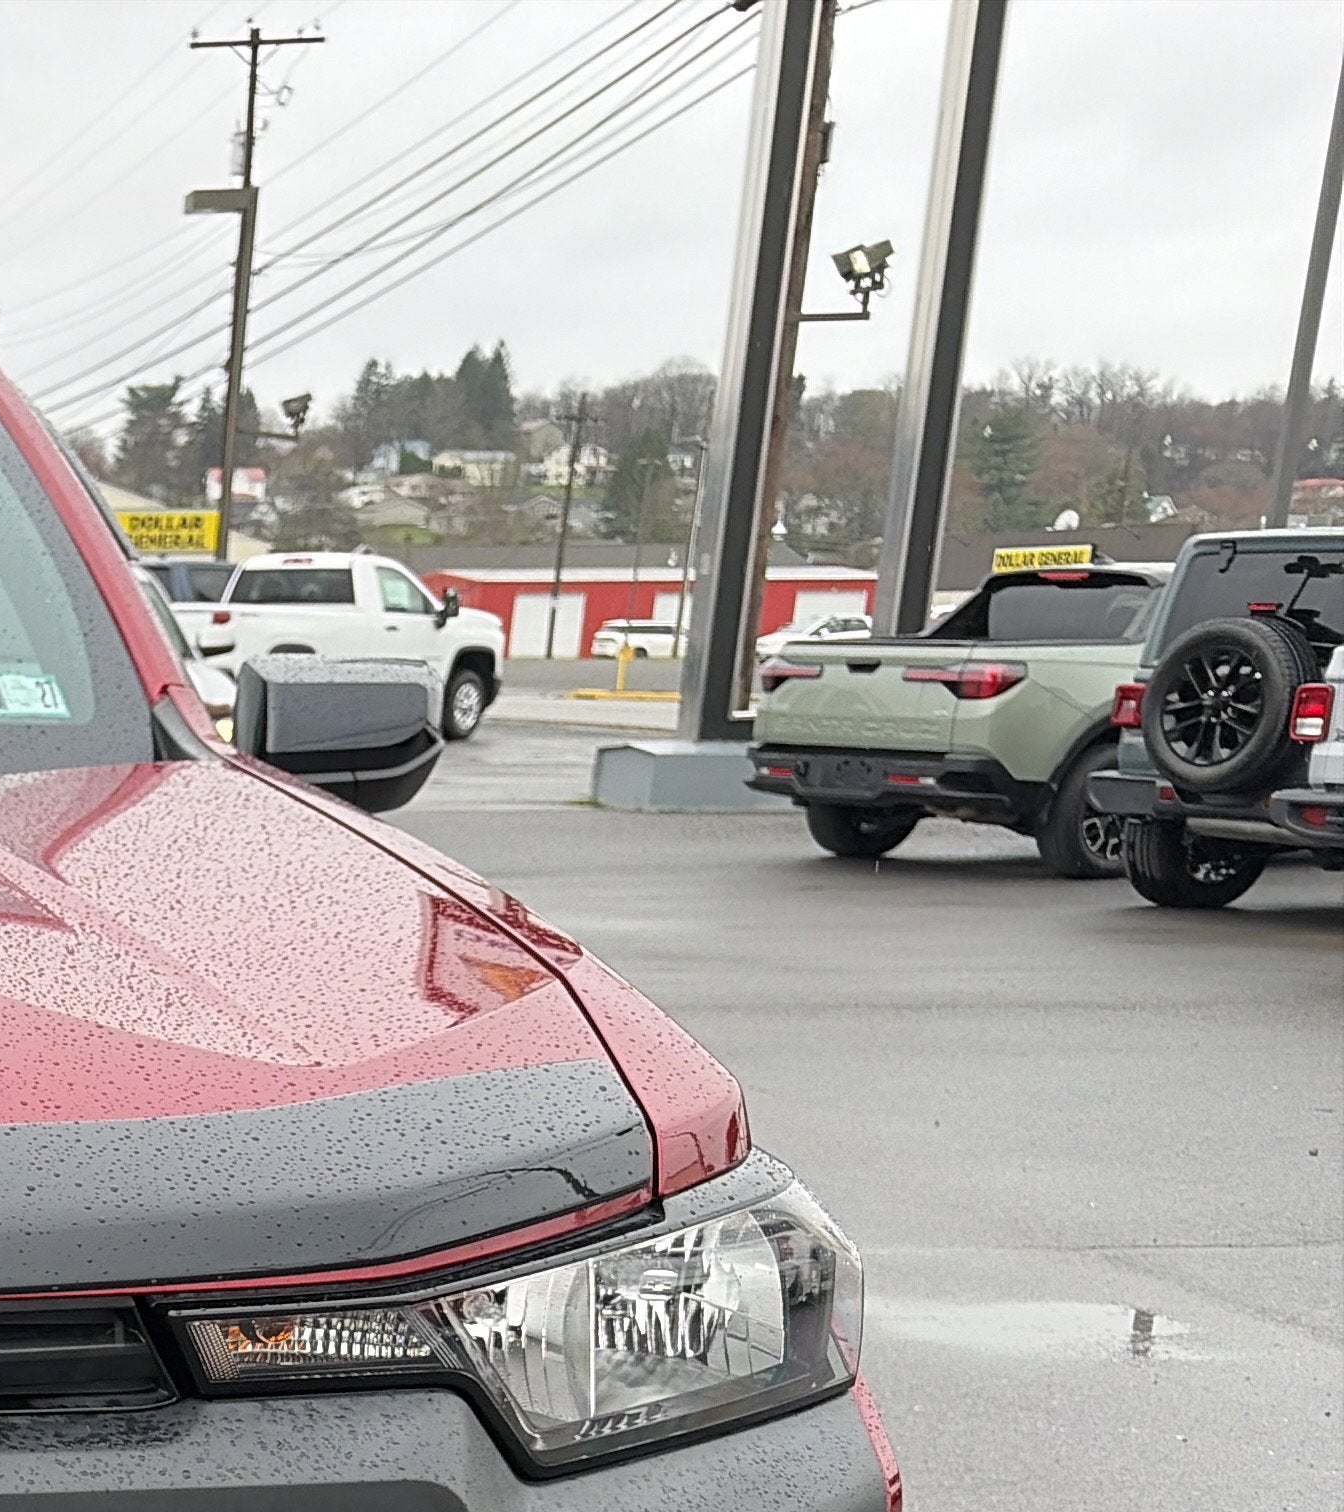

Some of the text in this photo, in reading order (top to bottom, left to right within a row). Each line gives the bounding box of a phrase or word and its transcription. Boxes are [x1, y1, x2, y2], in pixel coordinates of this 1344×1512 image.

[128, 516, 205, 530] DOLLAR
[996, 549, 1085, 568] DOLLAR GENERAL
